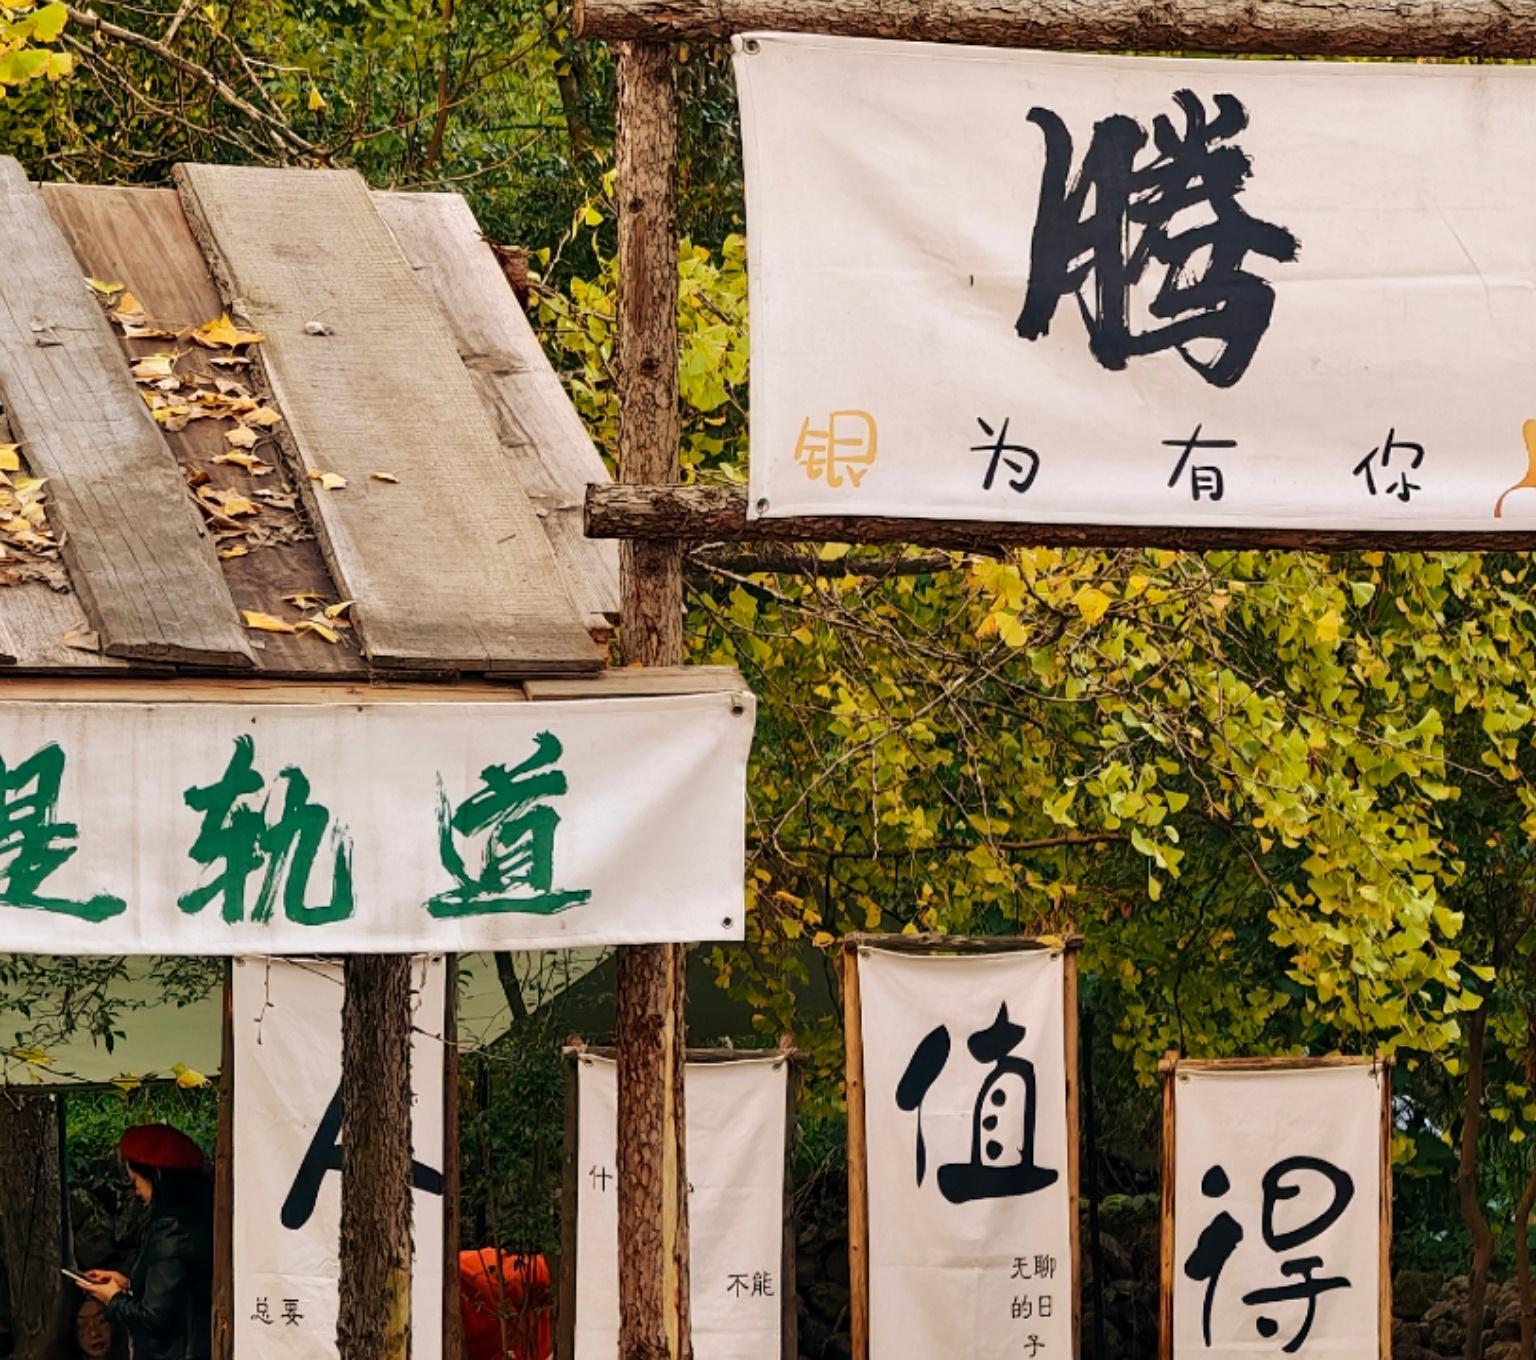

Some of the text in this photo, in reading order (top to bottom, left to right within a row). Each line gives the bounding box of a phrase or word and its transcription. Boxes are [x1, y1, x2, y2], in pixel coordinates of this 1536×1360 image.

[894, 1000, 1059, 1206] 值
[1010, 1253, 1057, 1280] 无聊
[1184, 1155, 1355, 1354] 得
[726, 1270, 775, 1298] 不能
[250, 1296, 304, 1327] 总要
[1010, 1294, 1053, 1320] 的日
[1023, 1333, 1046, 1359] 子
